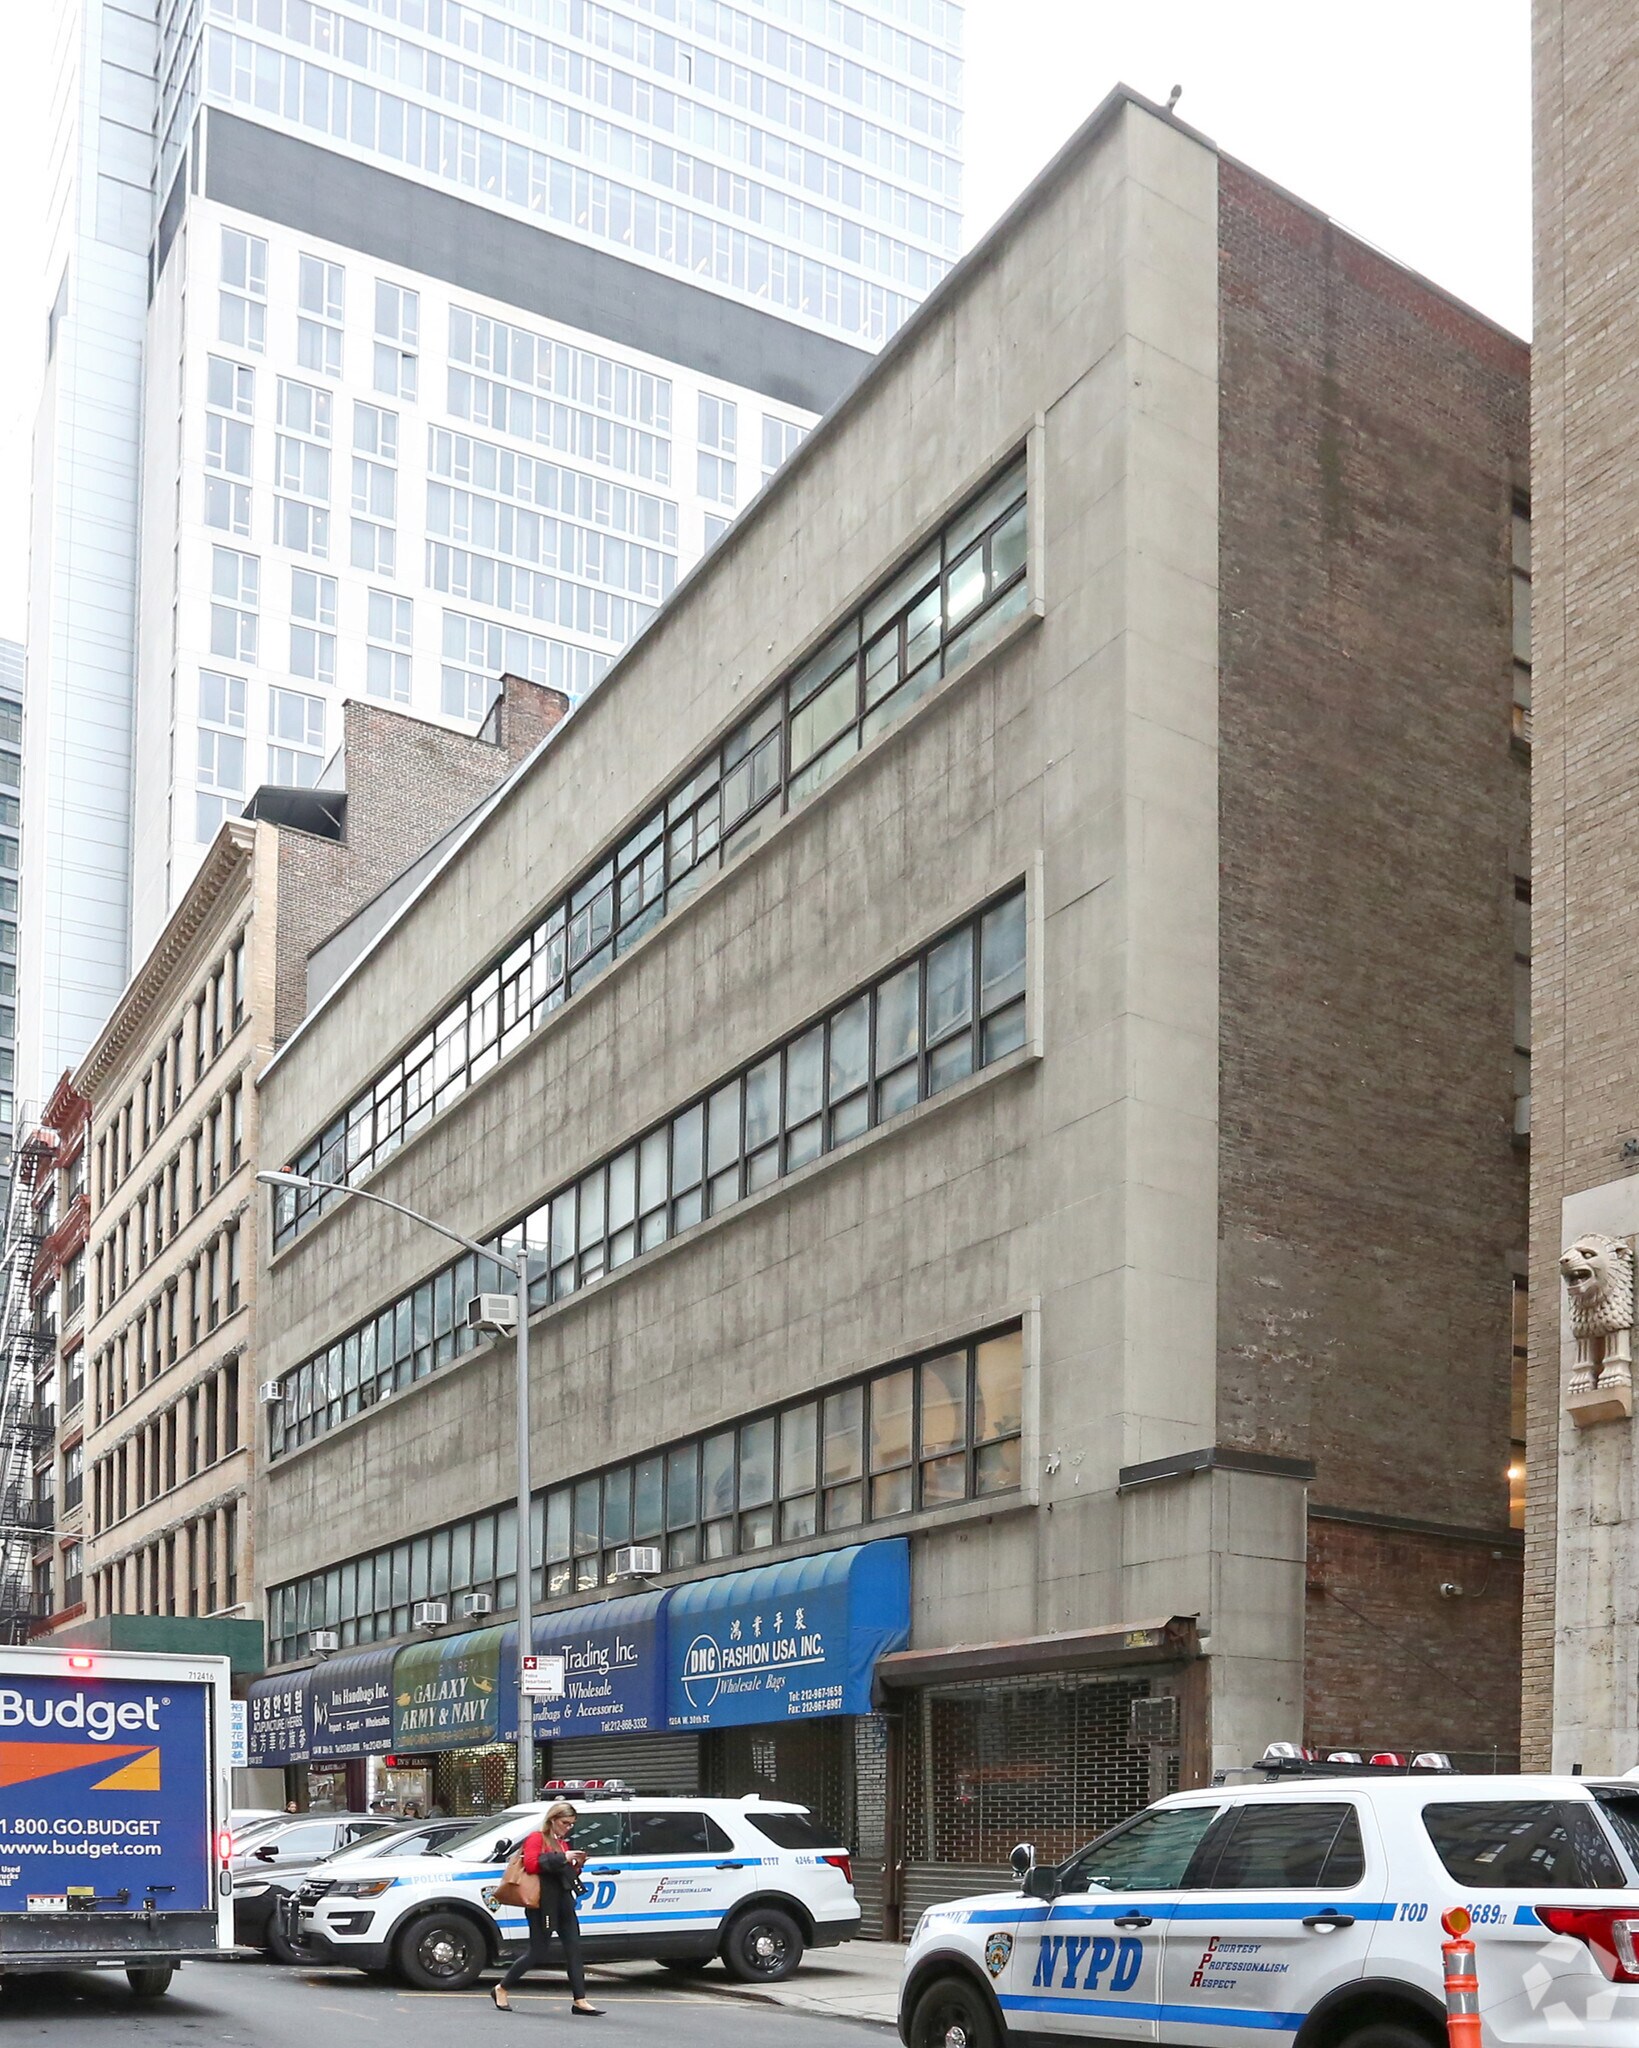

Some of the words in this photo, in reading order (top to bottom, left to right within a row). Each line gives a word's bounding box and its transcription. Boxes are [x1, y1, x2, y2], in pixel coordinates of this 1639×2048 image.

[562, 1640, 609, 1674] Trading
[616, 1636, 638, 1662] Inc.
[691, 1648, 716, 1673] DNC
[722, 1642, 769, 1668] FASHION
[772, 1638, 797, 1661] USA
[801, 1633, 824, 1656] INC.
[188, 1672, 214, 1680] 712416
[720, 1676, 761, 1694] Wholesale
[766, 1674, 786, 1693] Bags
[343, 1687, 374, 1705] Handbags
[376, 1683, 388, 1698] Inc.
[414, 1677, 468, 1703] GALAXY
[569, 1679, 612, 1699] Wholesale
[789, 1691, 800, 1702] Tel:
[0, 1690, 160, 1741] Budget
[400, 1707, 436, 1730] ARMY
[440, 1708, 449, 1725] &
[451, 1699, 489, 1723] NAVY
[533, 1707, 560, 1722] andbags
[564, 1705, 572, 1718] &
[576, 1701, 624, 1717] Accessories
[788, 1703, 800, 1714] Fax:
[346, 1720, 360, 1731] Export
[0, 1819, 161, 1836] 1.800.GO.BUDGET
[0, 1840, 162, 1858] www.budget.com
[2, 1865, 20, 1873] Used
[1400, 1903, 1428, 1921] TOD
[1032, 1936, 1142, 1992] NYPD
